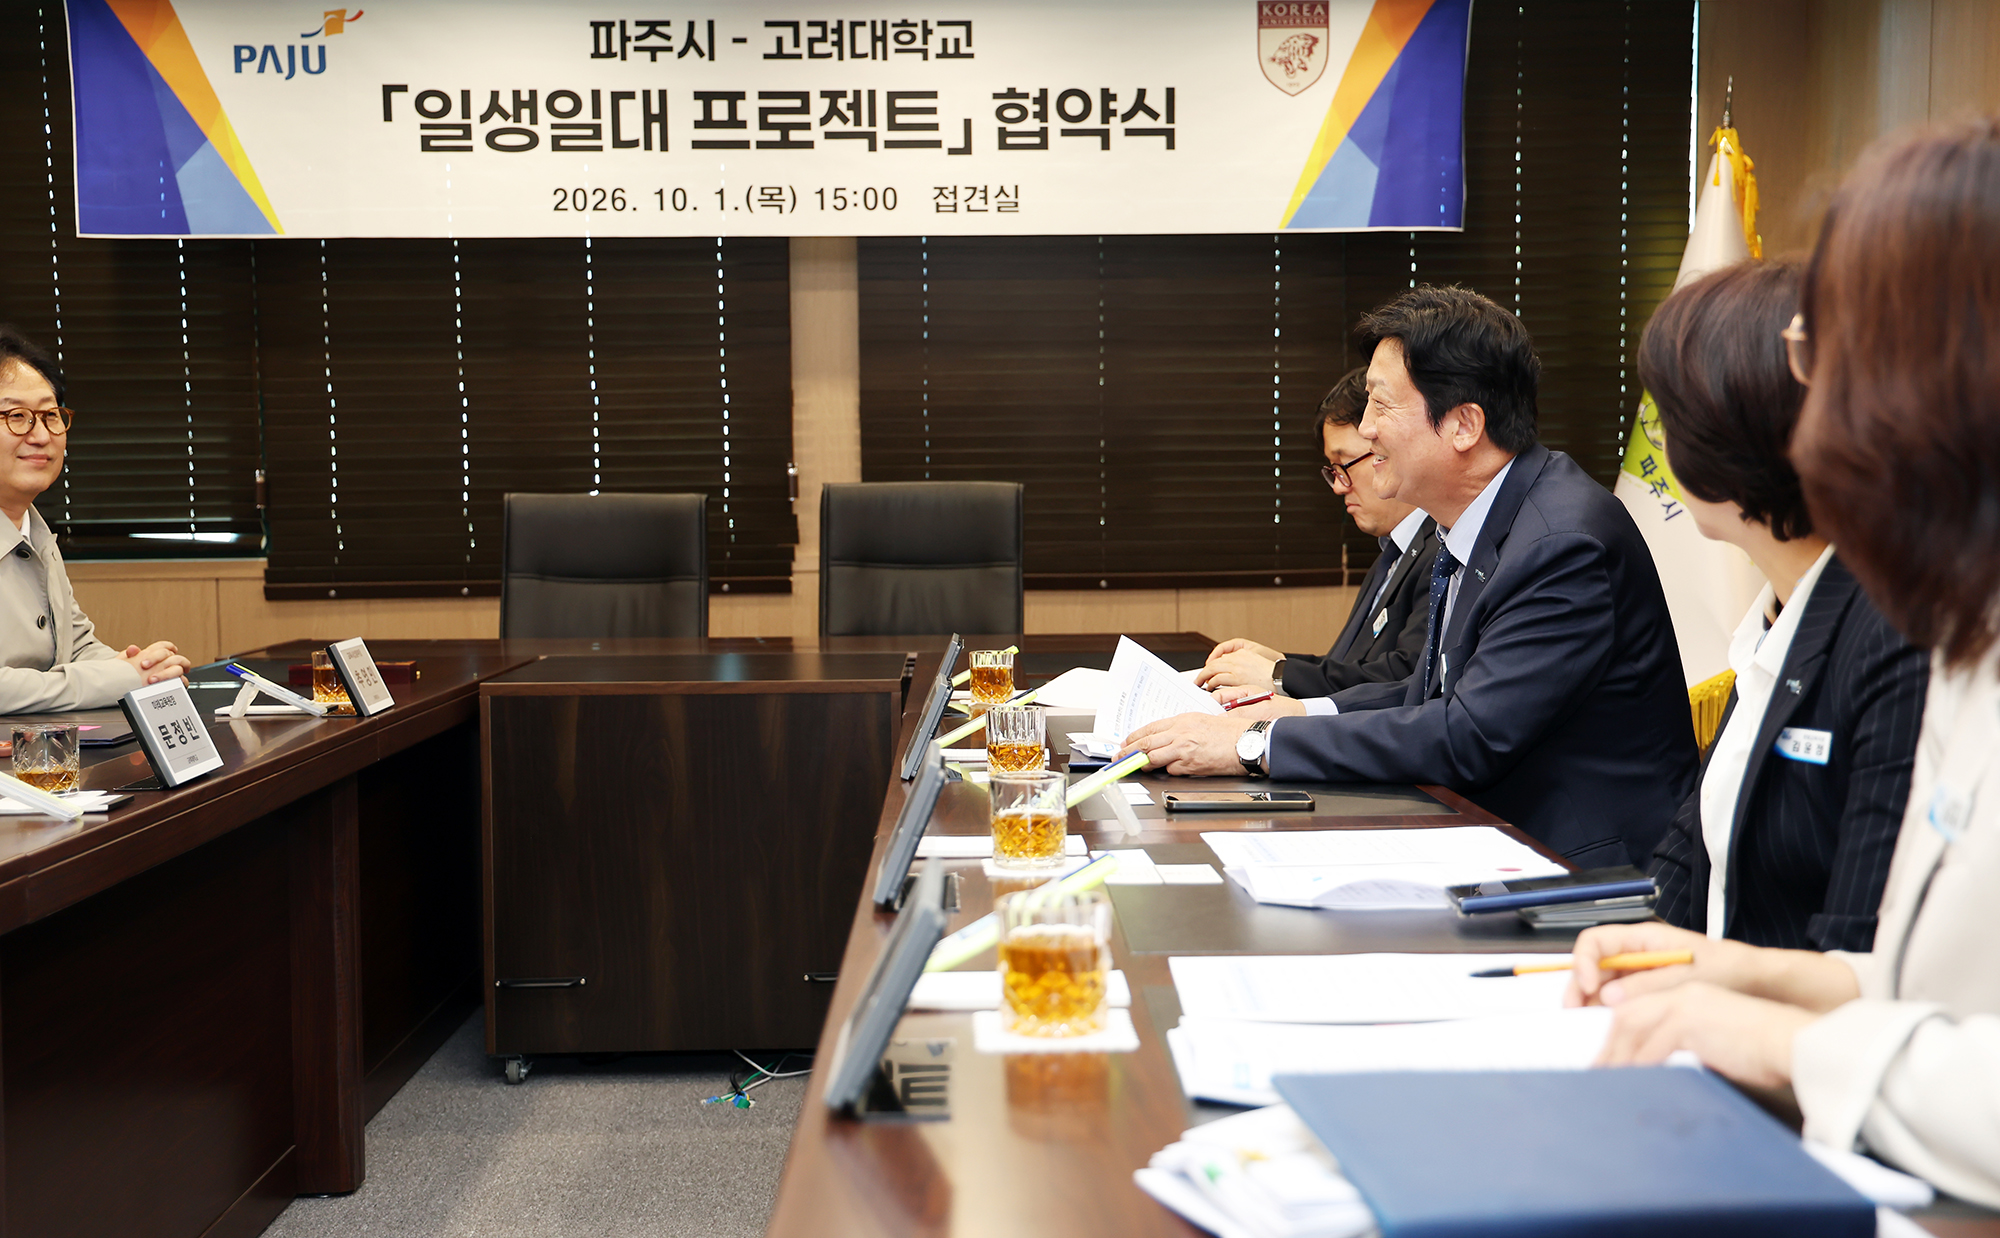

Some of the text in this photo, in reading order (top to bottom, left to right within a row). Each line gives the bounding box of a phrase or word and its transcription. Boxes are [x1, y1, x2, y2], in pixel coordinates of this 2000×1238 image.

[1262, 3, 1325, 17] KOREA
[589, 19, 716, 63] 파주시
[762, 18, 975, 62] 고려대학교
[233, 44, 327, 81] PAJU
[381, 84, 1176, 156] 「일생일대 프로젝트」 협약식
[553, 184, 1019, 214] 2026. 10. 1.(목) 15:00 접견실
[1639, 453, 1684, 522] 파주시
[158, 715, 200, 749] 문정빈
